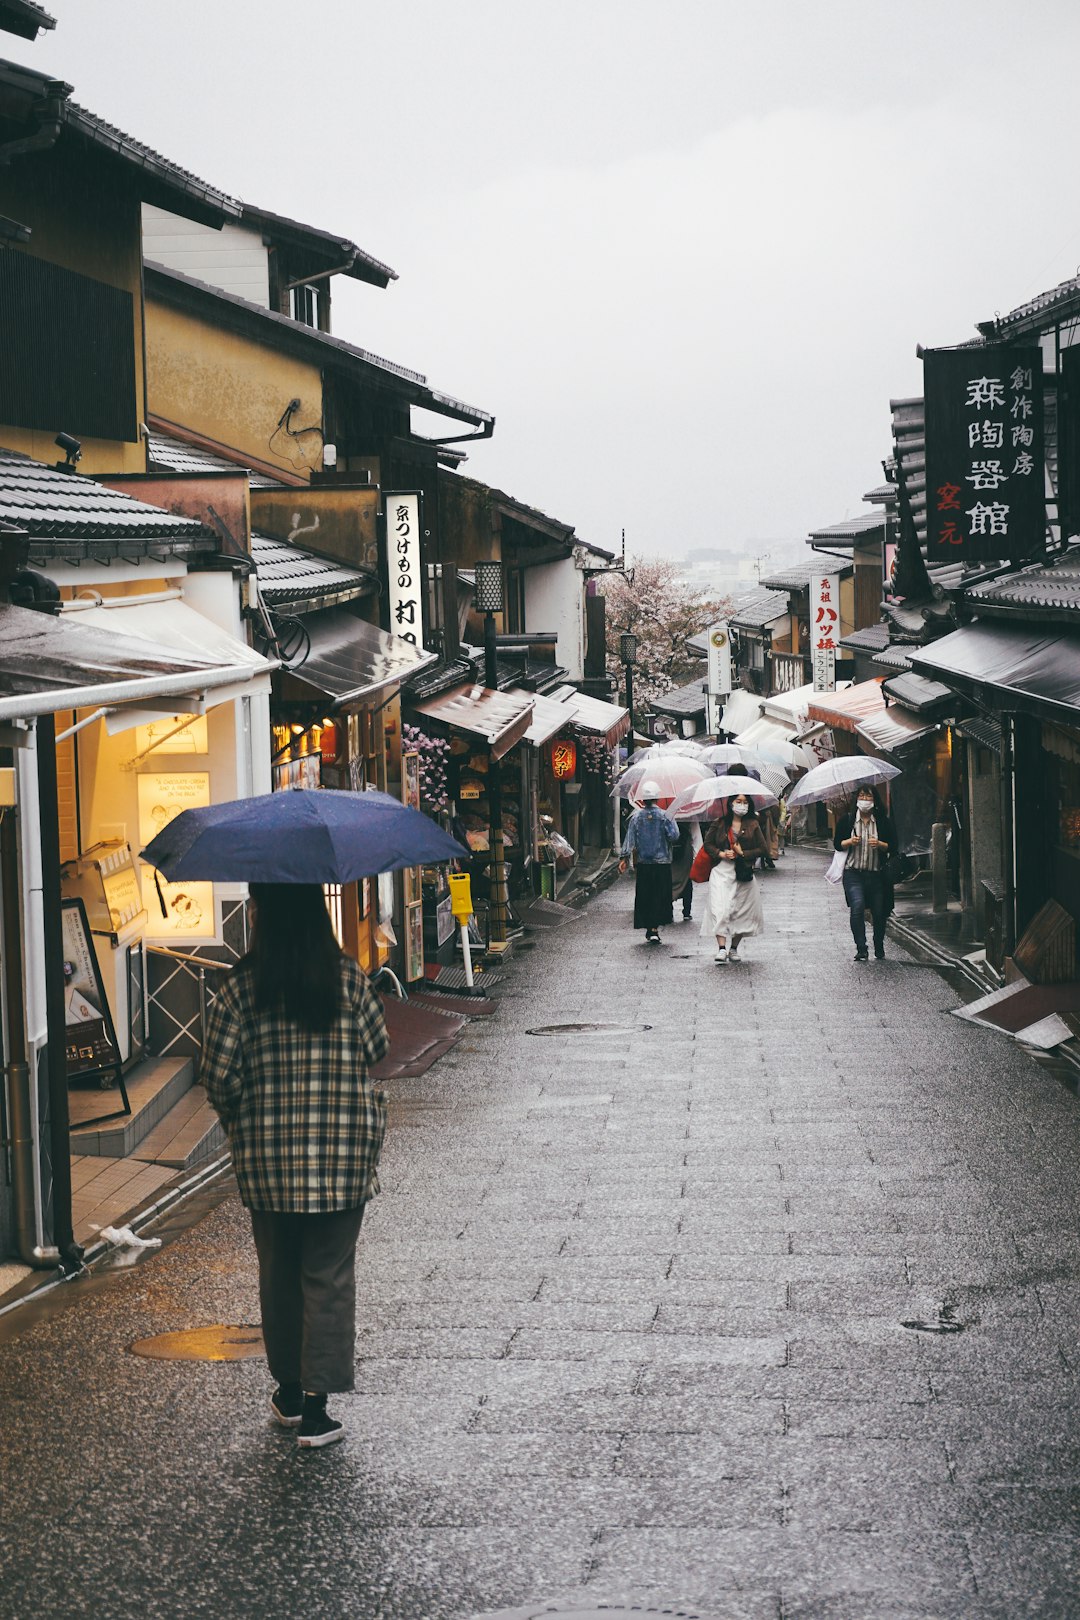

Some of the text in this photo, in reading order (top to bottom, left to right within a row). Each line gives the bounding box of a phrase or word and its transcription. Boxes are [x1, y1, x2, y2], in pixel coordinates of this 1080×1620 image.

[965, 375, 1010, 536] 森陶器館
[1010, 365, 1035, 476] 創作陶房
[395, 504, 412, 589] 京つけもの
[936, 481, 963, 545] 窯元
[820, 578, 832, 603] 元祖
[817, 651, 825, 691] こうらく堂
